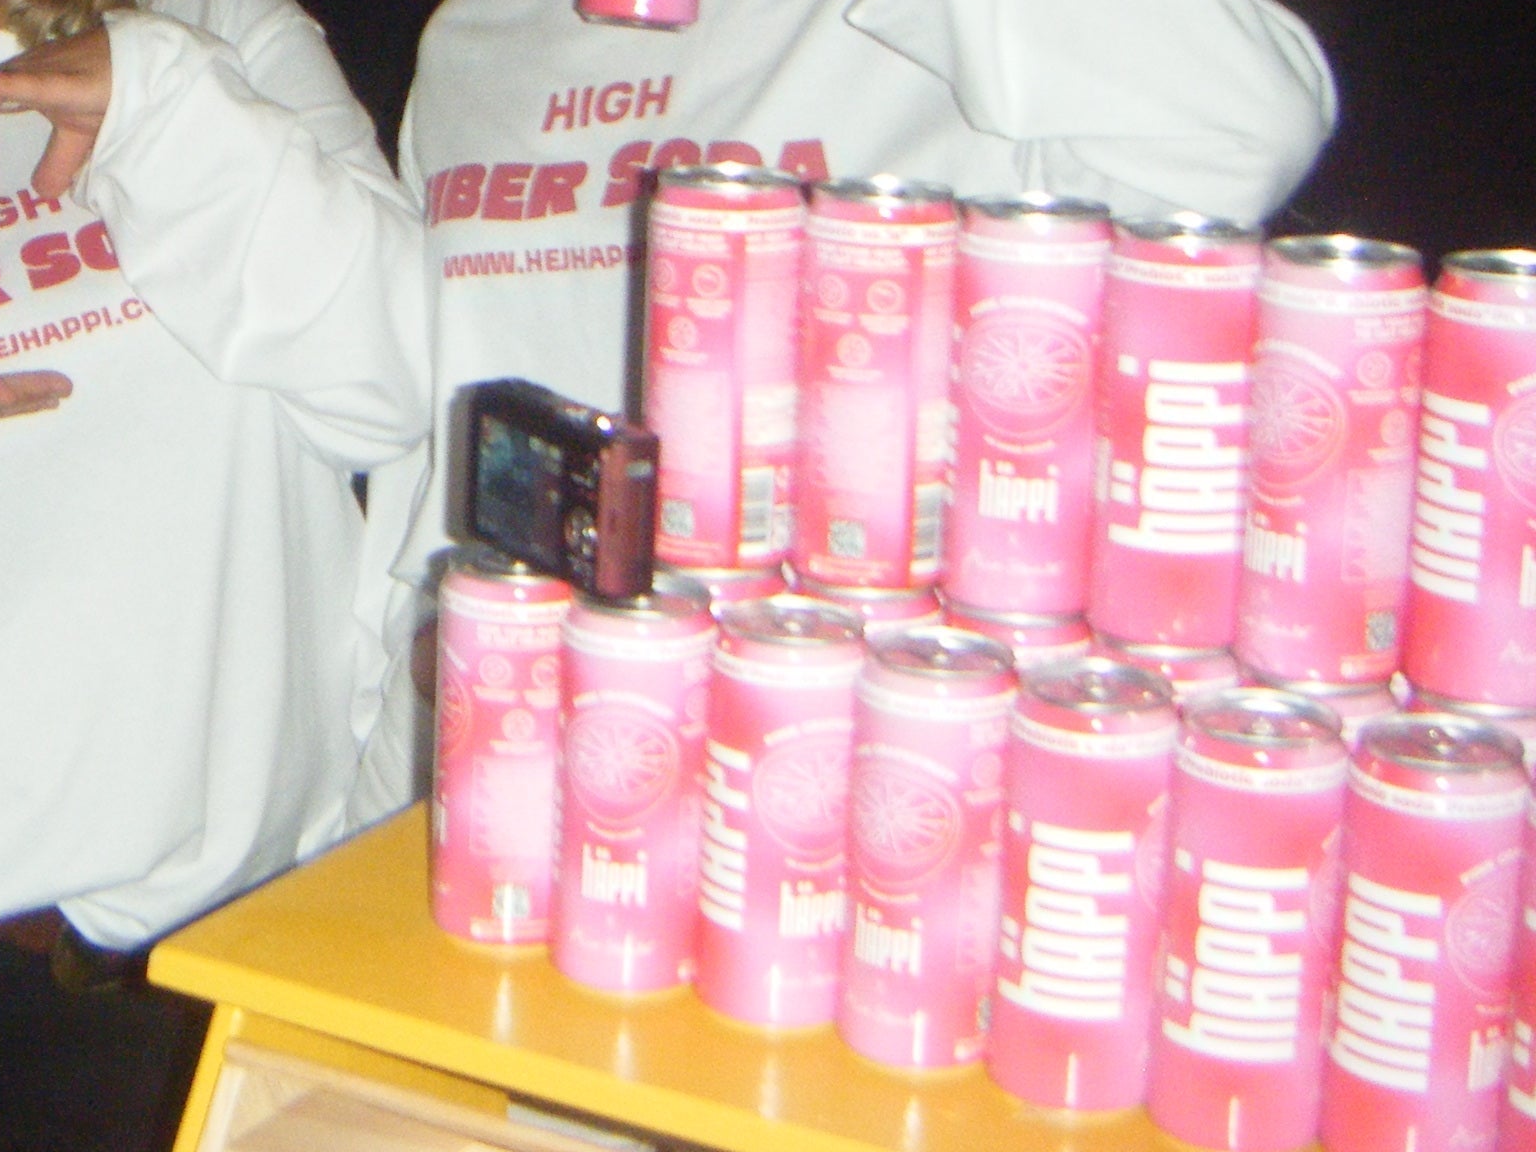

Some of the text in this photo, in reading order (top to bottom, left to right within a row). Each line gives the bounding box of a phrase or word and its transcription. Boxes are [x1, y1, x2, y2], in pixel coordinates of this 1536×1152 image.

[541, 76, 674, 134] HIGH
[426, 160, 589, 229] IBER
[20, 219, 120, 291] SO
[443, 244, 627, 279] WWW.HEJHAP
